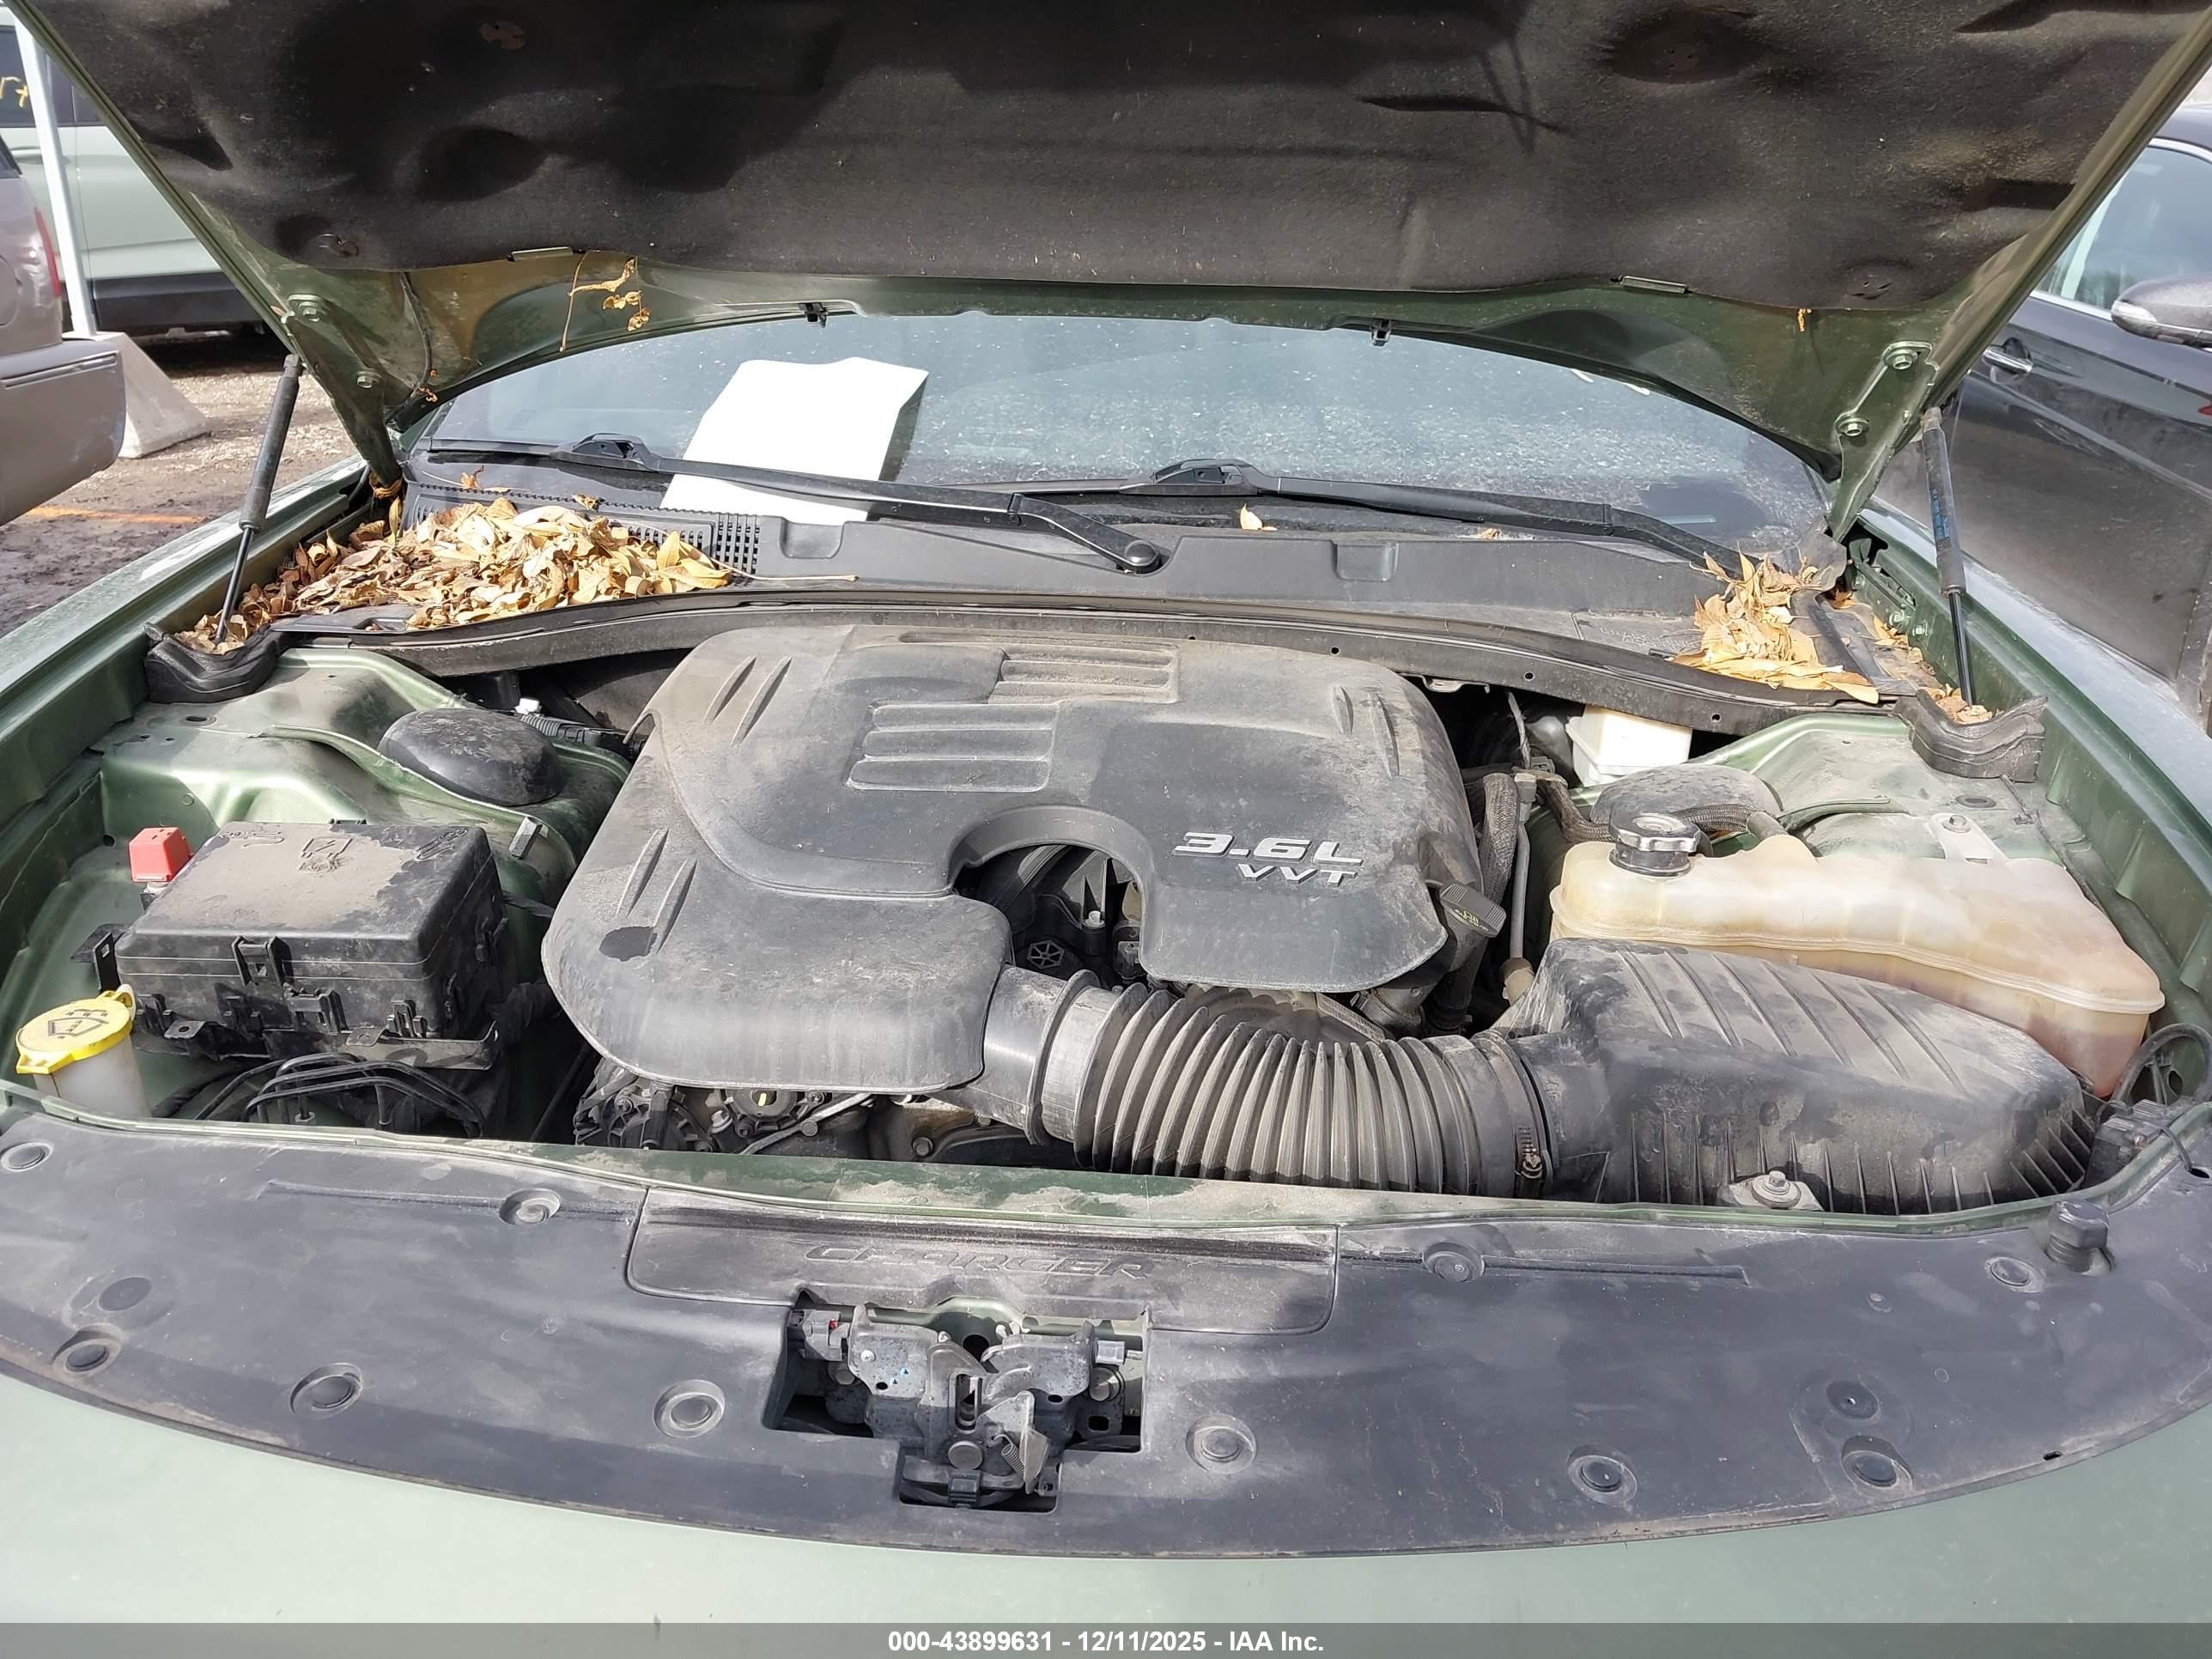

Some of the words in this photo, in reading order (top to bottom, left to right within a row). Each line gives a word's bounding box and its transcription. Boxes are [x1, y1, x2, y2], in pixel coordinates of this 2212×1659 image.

[1173, 832, 1365, 866] 3.6L
[1237, 863, 1358, 887] VVT
[804, 1244, 1155, 1280] CHARGER
